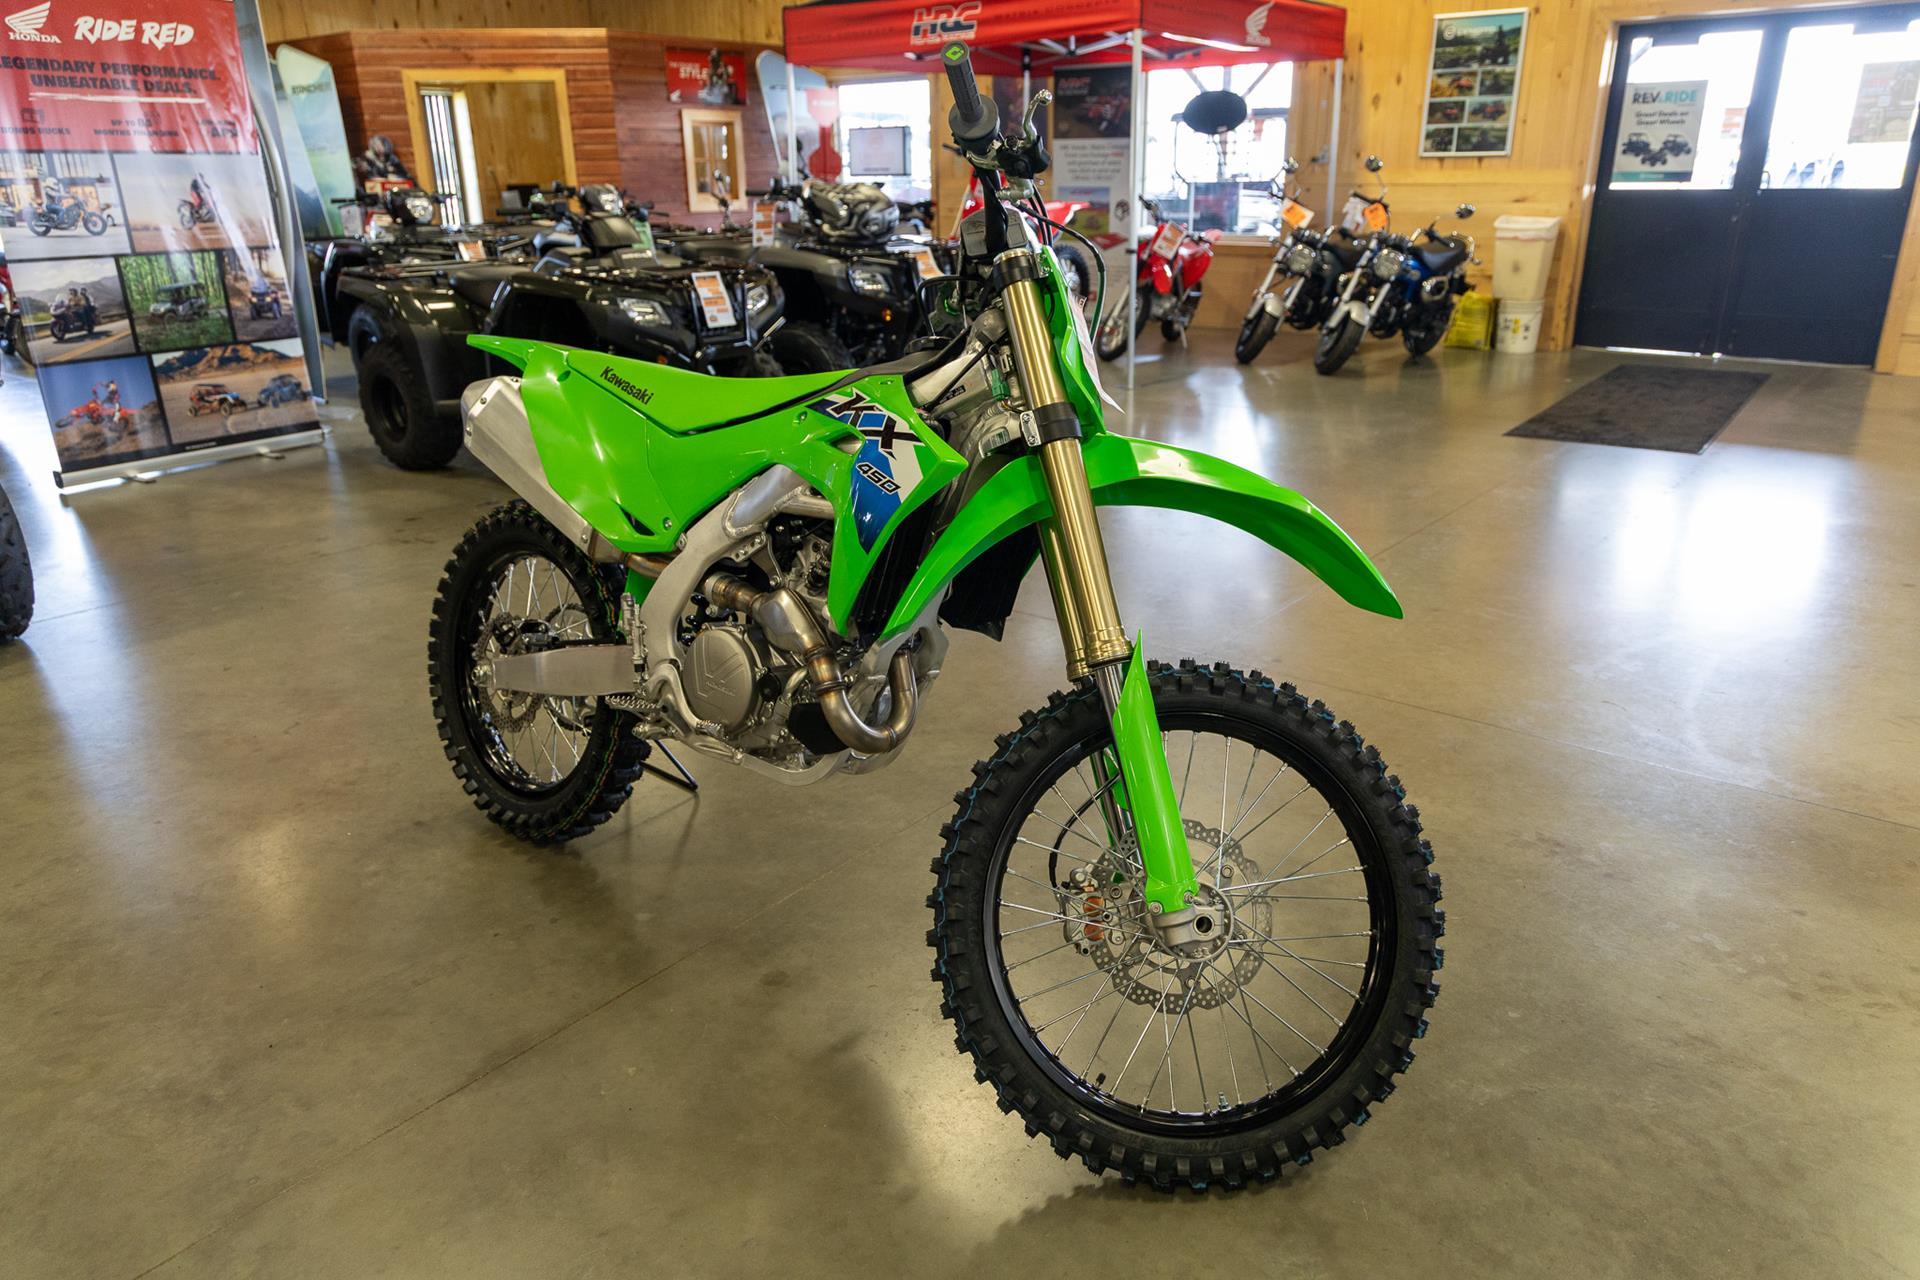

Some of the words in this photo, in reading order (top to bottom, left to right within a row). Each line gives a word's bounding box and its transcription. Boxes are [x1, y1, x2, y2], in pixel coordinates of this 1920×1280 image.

[8, 32, 62, 43] HONDA
[74, 16, 137, 44] RIDE
[141, 22, 194, 50] RED
[30, 74, 140, 91] UNBEATABLE
[1632, 91, 1661, 104] REV
[1664, 88, 1698, 103] RIDE
[600, 366, 654, 405] Kawasaki
[826, 389, 925, 460] KX
[856, 462, 901, 494] 450
